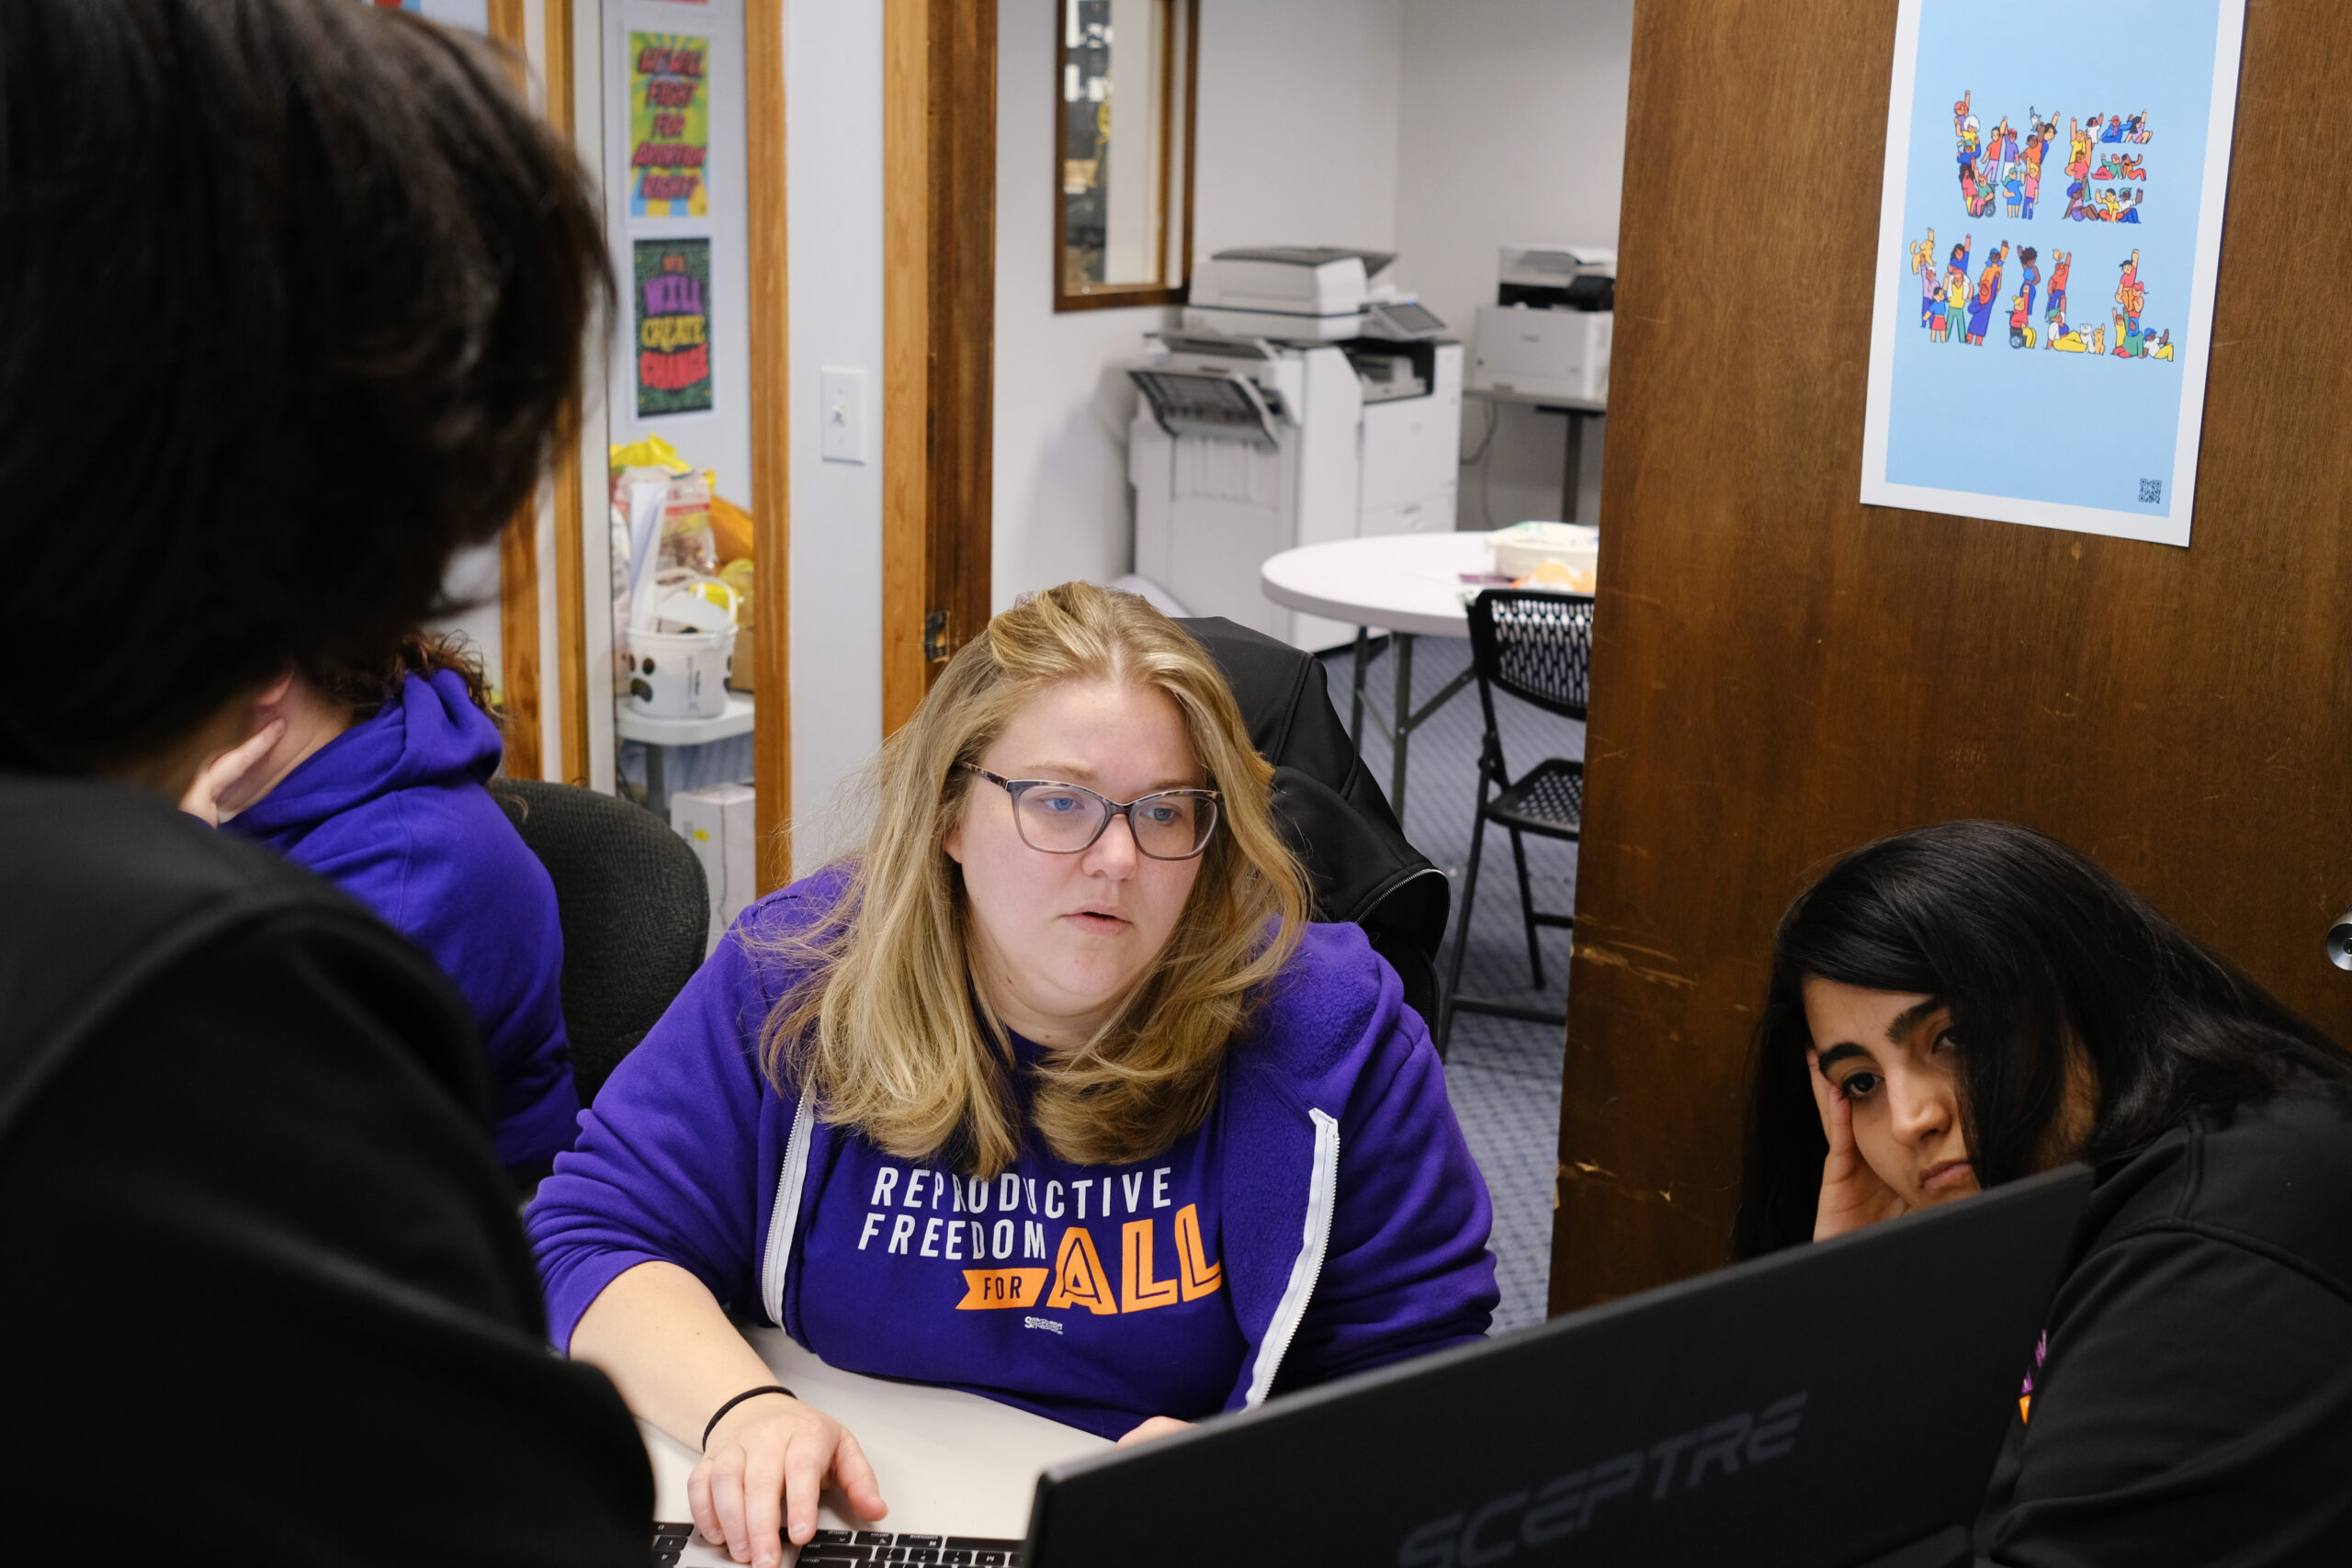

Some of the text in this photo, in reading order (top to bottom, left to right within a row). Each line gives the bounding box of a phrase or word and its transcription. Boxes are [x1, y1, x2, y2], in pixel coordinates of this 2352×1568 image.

[1953, 90, 2154, 223] WE
[644, 273, 704, 316] WILL
[1910, 228, 2174, 362] WILL
[641, 315, 706, 352] CREATE
[871, 1167, 1171, 1220] REPRODUCTIVE
[857, 1213, 1046, 1260] FREEDOM
[1046, 1203, 1222, 1315] ALL
[983, 1276, 1022, 1300] FOR
[1398, 1391, 1808, 1568] SCEPTRE
